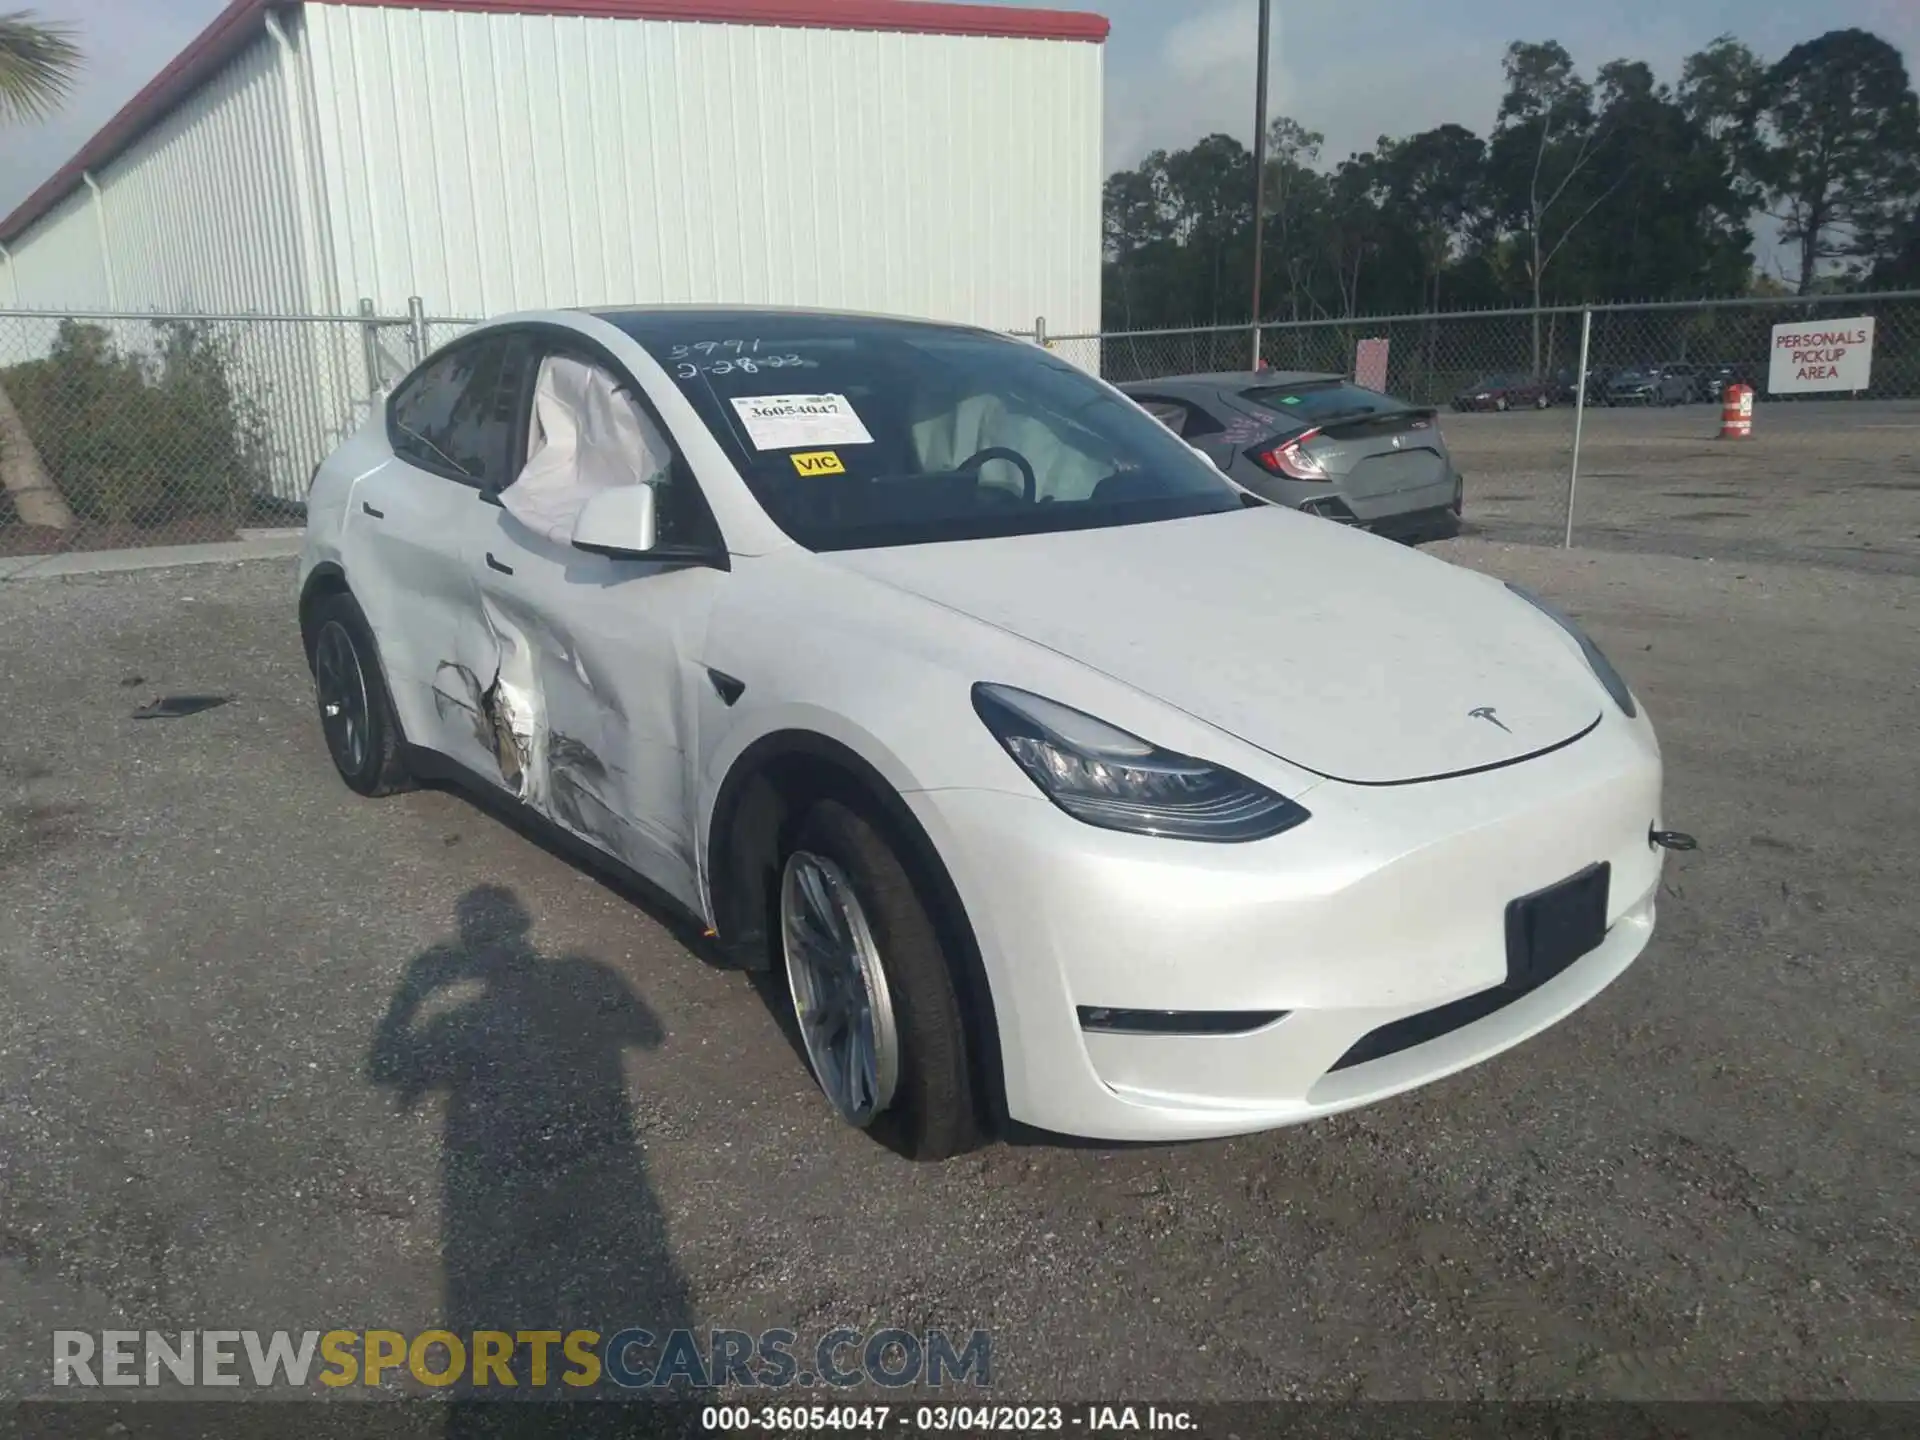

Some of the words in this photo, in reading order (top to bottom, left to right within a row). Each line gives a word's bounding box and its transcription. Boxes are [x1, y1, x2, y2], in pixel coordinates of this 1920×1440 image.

[1776, 330, 1866, 349] PERSONALS
[1791, 348, 1846, 364] PICKUP
[1796, 366, 1838, 380] AREA
[750, 404, 839, 418] 36054047
[797, 455, 838, 471] VIC
